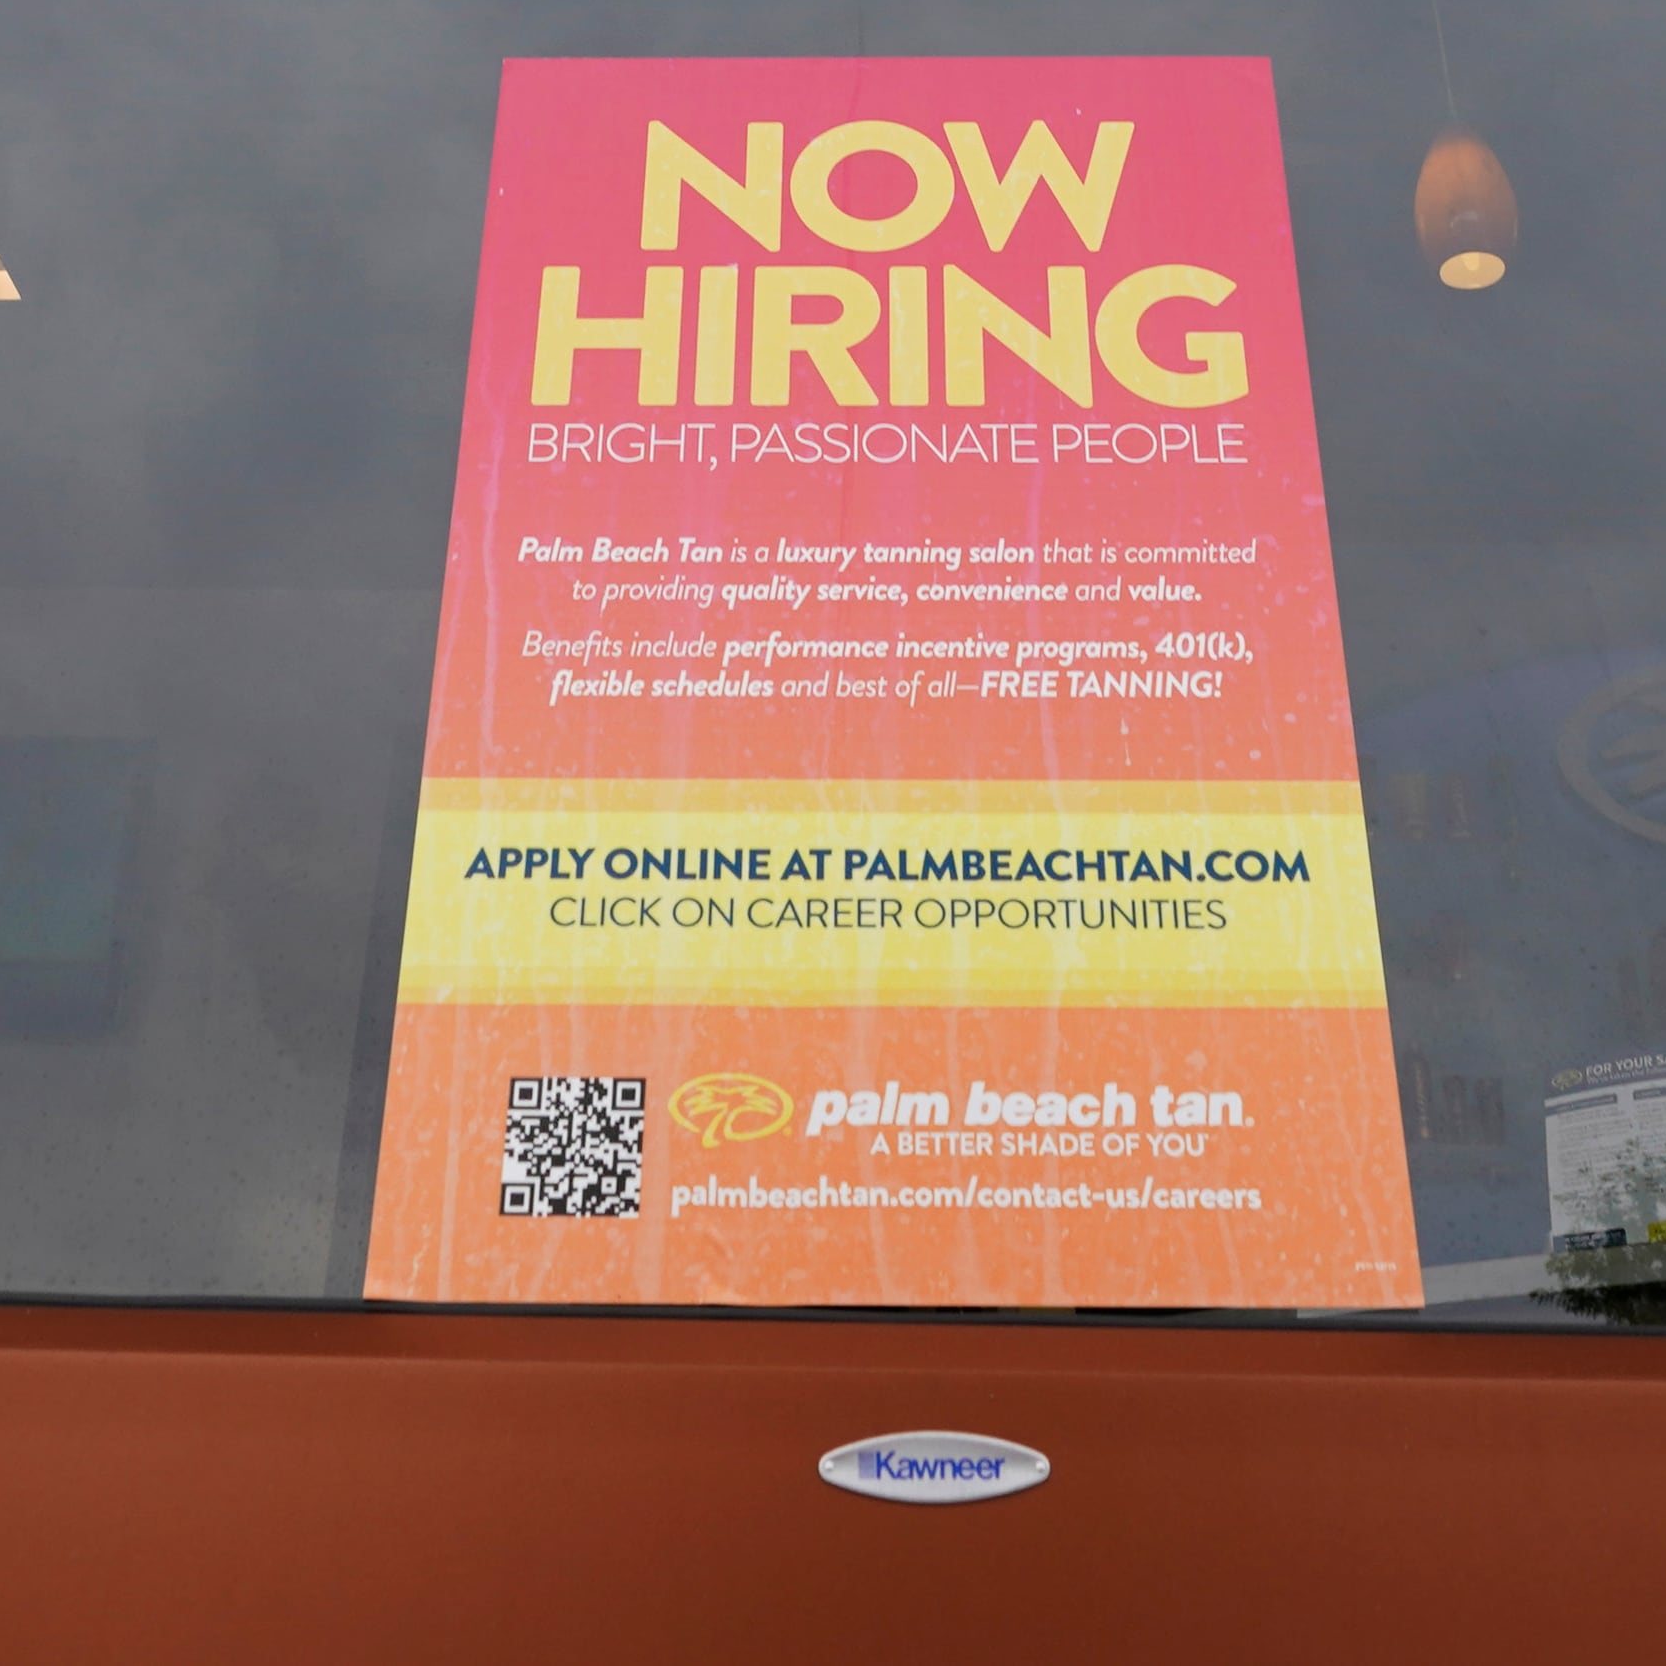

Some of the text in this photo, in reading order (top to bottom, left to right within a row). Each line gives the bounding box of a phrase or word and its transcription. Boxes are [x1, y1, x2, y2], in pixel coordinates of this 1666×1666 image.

[640, 118, 1136, 254] NOW
[529, 263, 1250, 410] HIRING
[527, 422, 1249, 473] BRIGHT, PASSIONATE PEOPLE
[517, 536, 1258, 573] Palm Beach Tan is a luxury tanning salon that is committed
[571, 574, 1203, 611] to providing quality service, convenience and value.
[521, 631, 1255, 668] Benefits include performance incentive programs, 401(k),
[548, 668, 645, 707] flexible
[650, 669, 775, 699] schedules
[780, 670, 830, 699] and
[835, 670, 888, 699] best
[894, 669, 926, 708] of
[1066, 669, 1224, 700] TANNING!
[464, 847, 1311, 885] APPLY ONLINE AT PALMBEACHTAN.COM
[548, 896, 1228, 932] CLICK ON CAREER OPPORTUNITIES
[1585, 1061, 1612, 1077] FOR
[1615, 1055, 1653, 1073] YOUR
[805, 1081, 950, 1137] palm
[963, 1081, 1137, 1128] beach
[869, 1132, 891, 1156] A
[897, 1132, 993, 1157] BETTER
[1000, 1132, 1096, 1158] SHADE
[1101, 1132, 1140, 1158] OF
[670, 1175, 1263, 1217] palmbeachtan.com/contact-us/careers
[875, 1450, 1006, 1481] Kawneer
